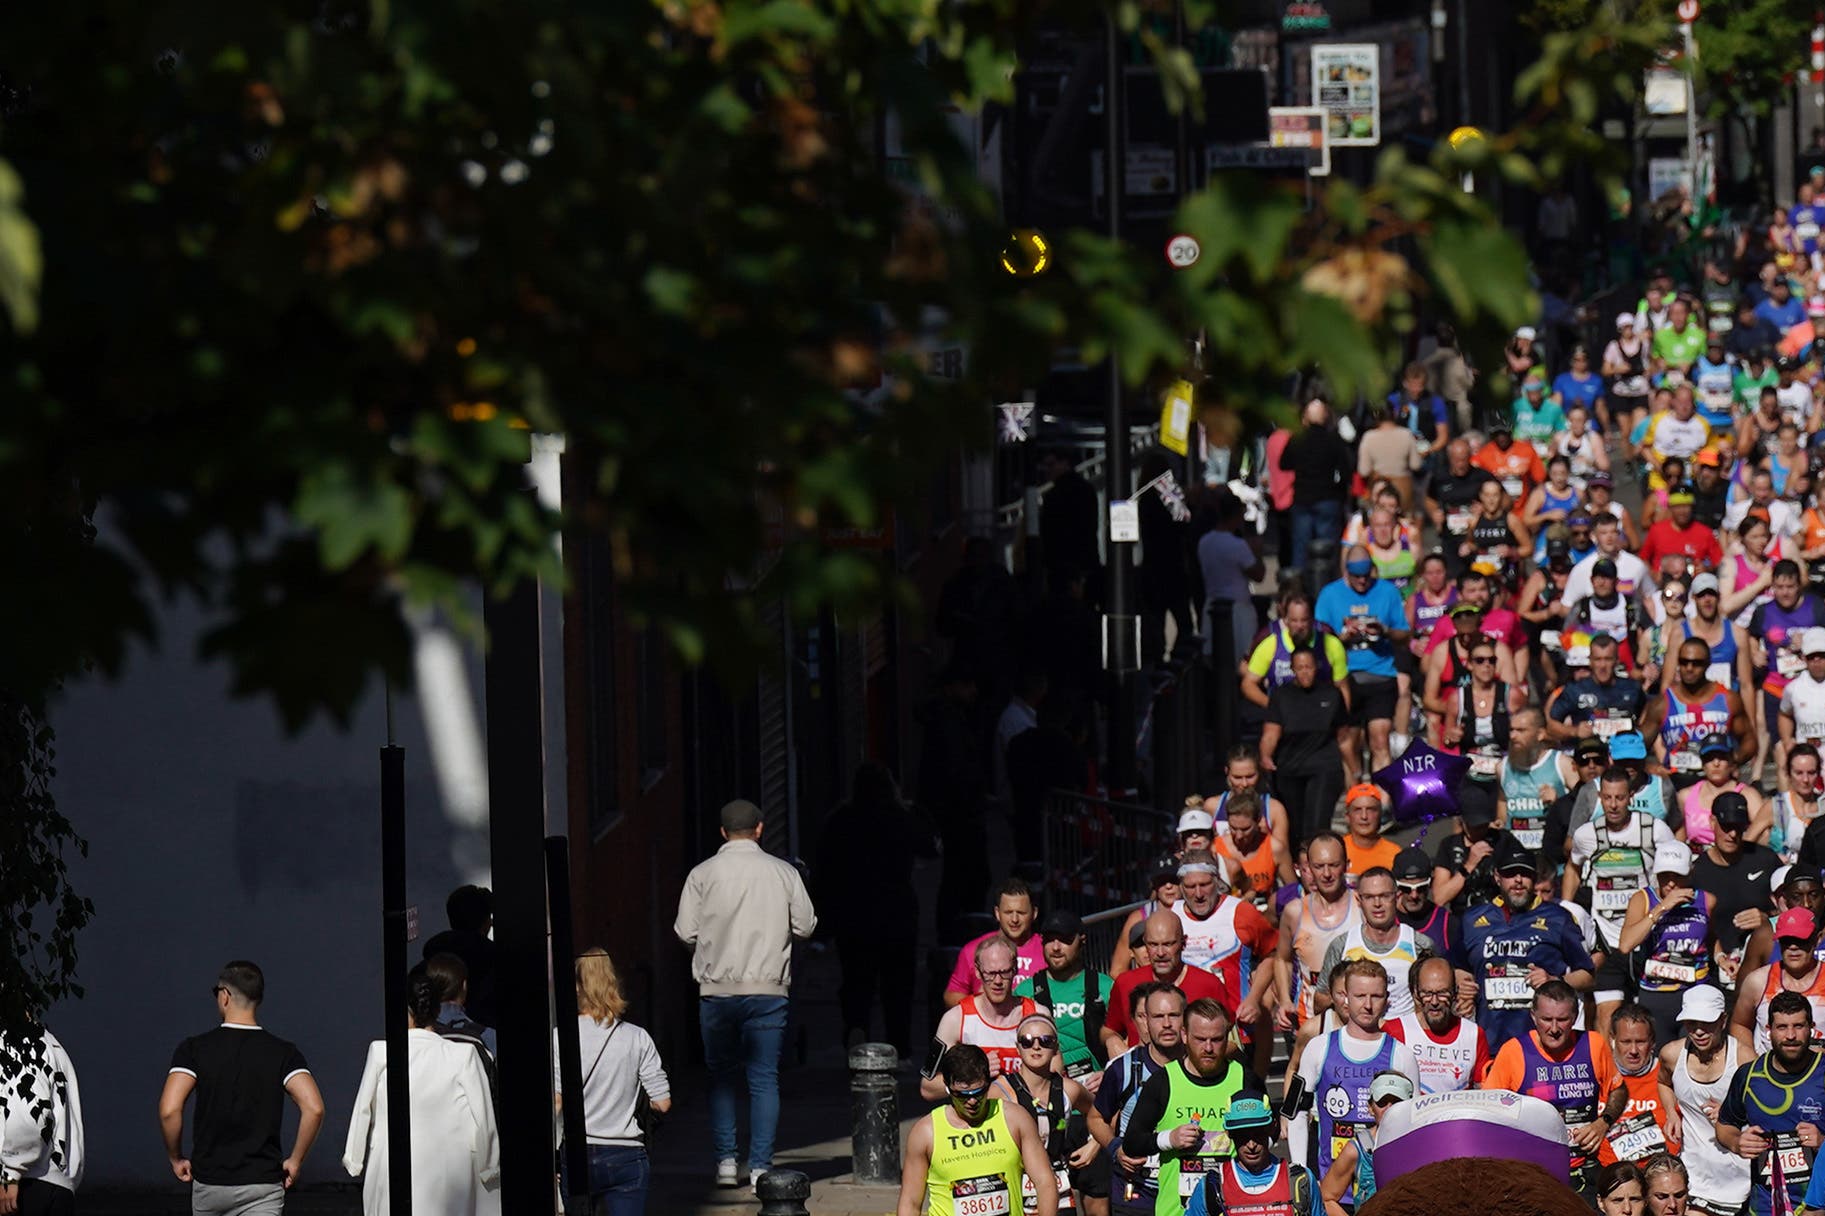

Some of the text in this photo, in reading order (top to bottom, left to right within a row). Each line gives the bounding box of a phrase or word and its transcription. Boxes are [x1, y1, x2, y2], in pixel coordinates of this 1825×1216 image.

[1172, 241, 1195, 259] 20
[1402, 754, 1436, 776] NIR
[1491, 980, 1530, 995] 13160
[1412, 1045, 1471, 1061] STEVE
[1537, 1064, 1588, 1080] MARK
[1414, 1088, 1500, 1111] WellChild
[1583, 1090, 1594, 1098] UK
[1175, 1105, 1224, 1120] STUAR
[947, 1128, 995, 1150] TOM
[941, 1148, 1006, 1164] Havens Hospices
[960, 1195, 1004, 1215] 38612
